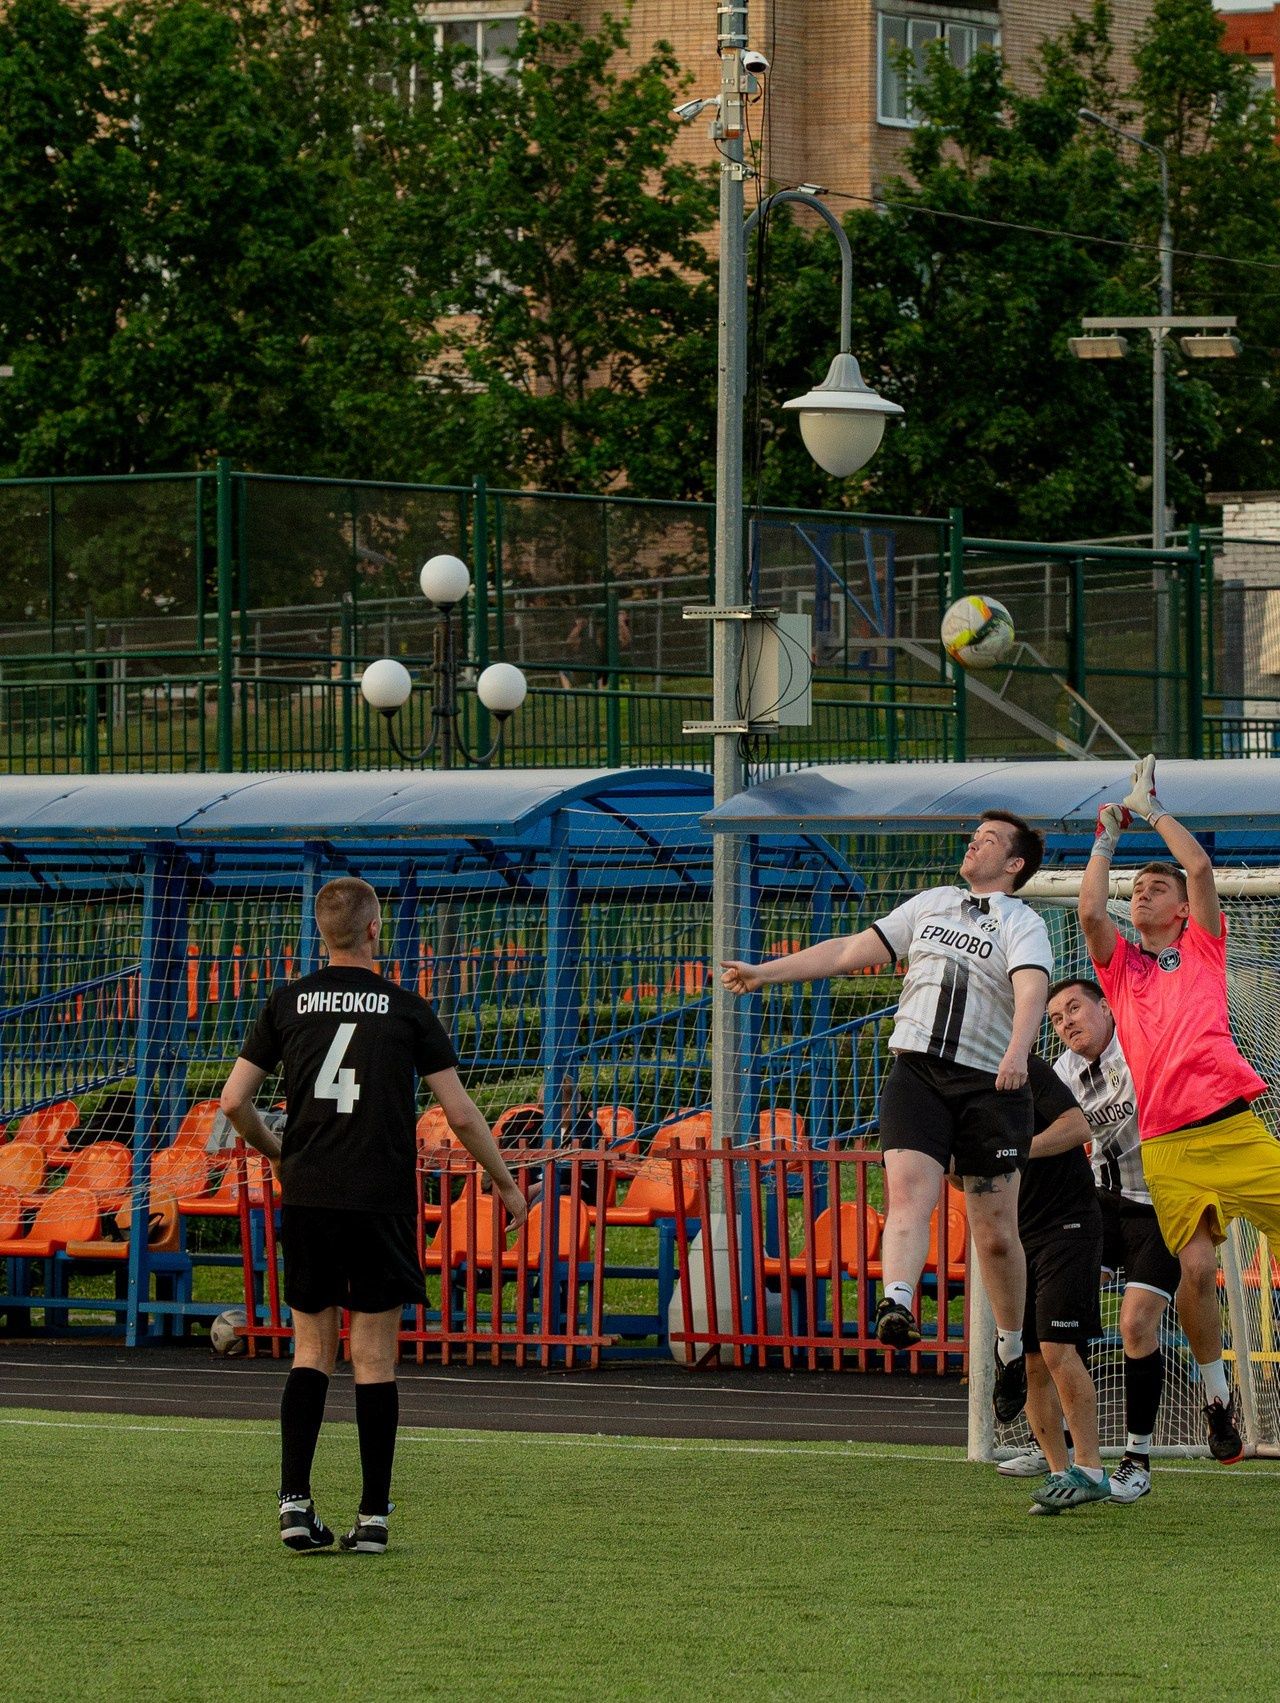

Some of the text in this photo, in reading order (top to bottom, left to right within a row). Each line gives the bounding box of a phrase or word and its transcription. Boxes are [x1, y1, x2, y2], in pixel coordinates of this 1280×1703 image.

[920, 925, 993, 959] ЕРШОВО
[297, 992, 389, 1014] СИНЕОКОВ
[314, 1023, 360, 1113] 4
[1084, 1101, 1133, 1126] РШОВО
